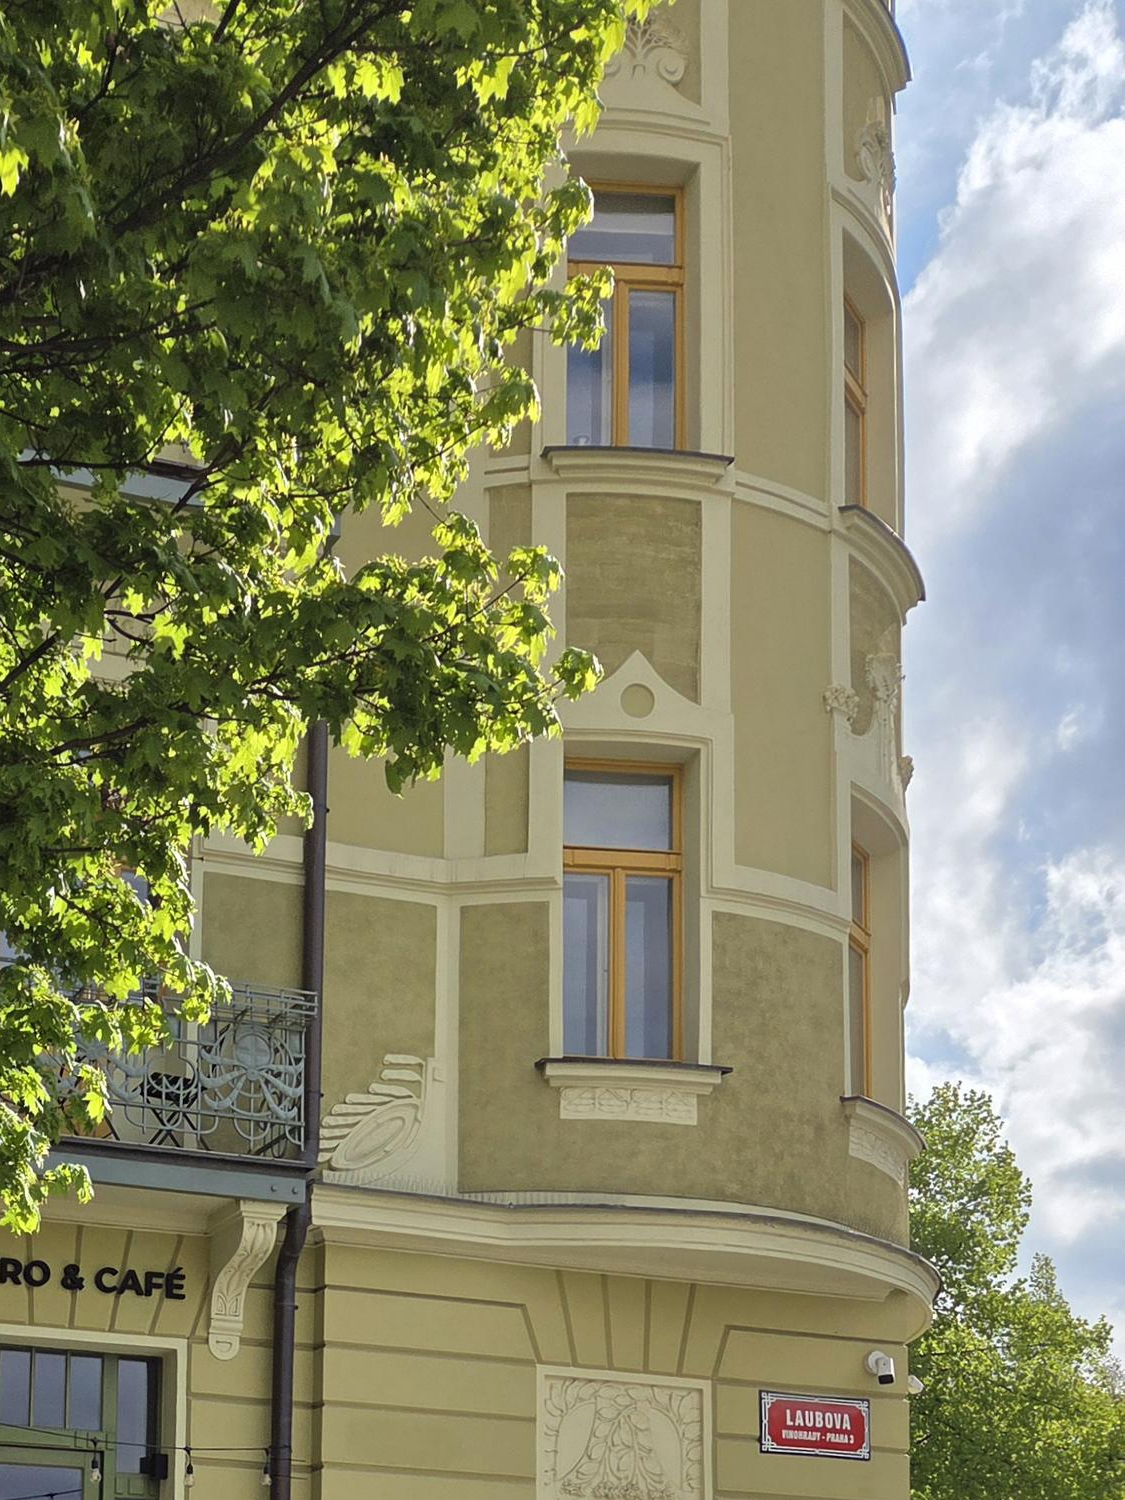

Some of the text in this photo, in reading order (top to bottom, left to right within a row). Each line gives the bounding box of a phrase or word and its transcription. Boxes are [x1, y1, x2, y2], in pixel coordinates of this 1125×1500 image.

[60, 1263, 85, 1291] &
[94, 1266, 187, 1301] CAFÉ
[786, 1409, 851, 1430] LAUBOVA
[782, 1430, 820, 1441] VINOHRADY
[826, 1434, 848, 1444] PRAHA
